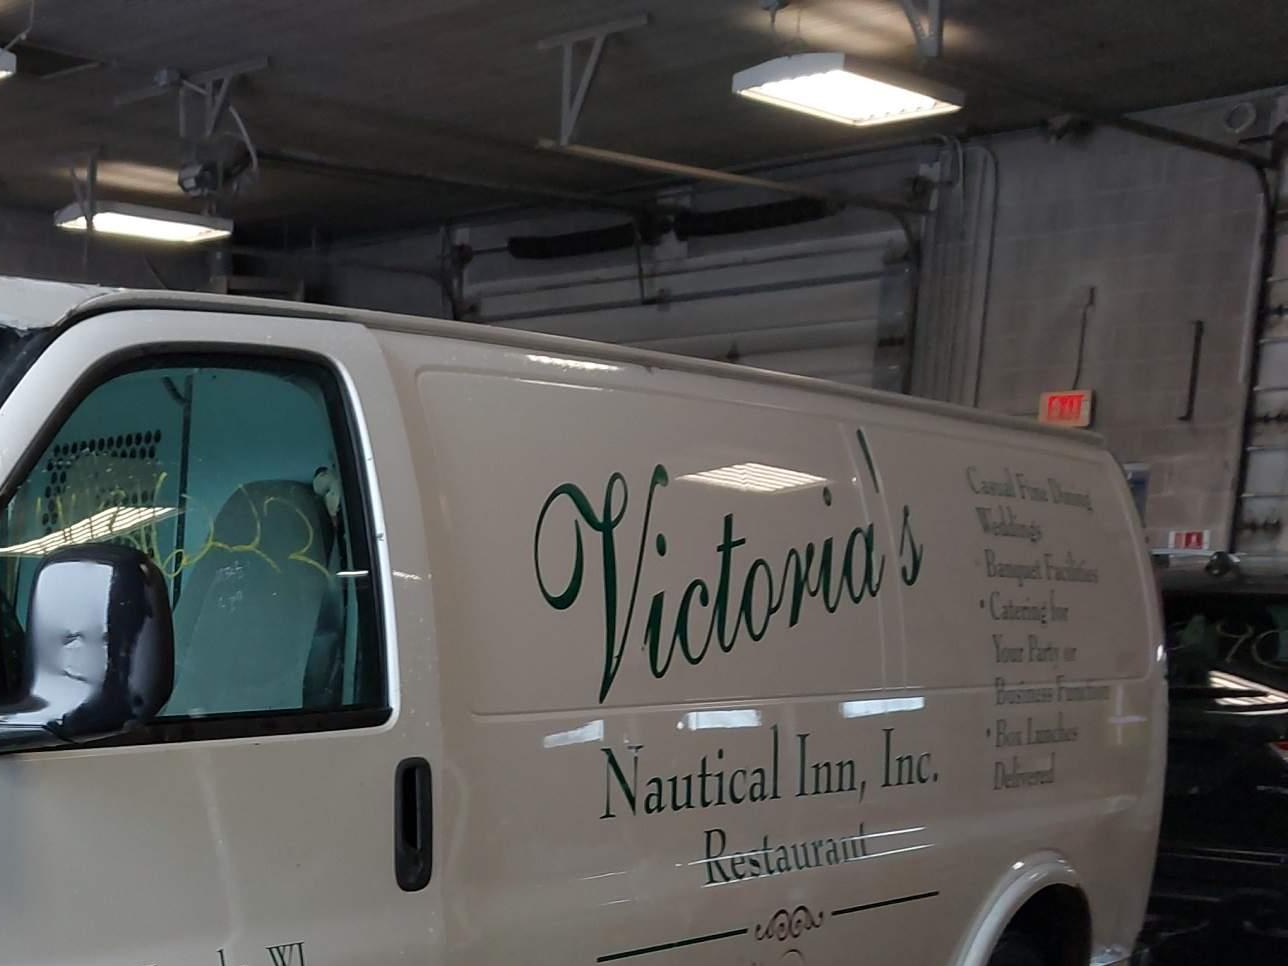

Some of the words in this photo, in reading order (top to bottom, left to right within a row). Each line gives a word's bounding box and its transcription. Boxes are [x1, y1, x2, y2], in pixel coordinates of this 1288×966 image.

[534, 428, 924, 704] Victoria's
[600, 724, 781, 819] Nautical
[795, 733, 867, 803] Inn,
[880, 728, 939, 788] Inc.
[703, 822, 867, 886] Restaurant
